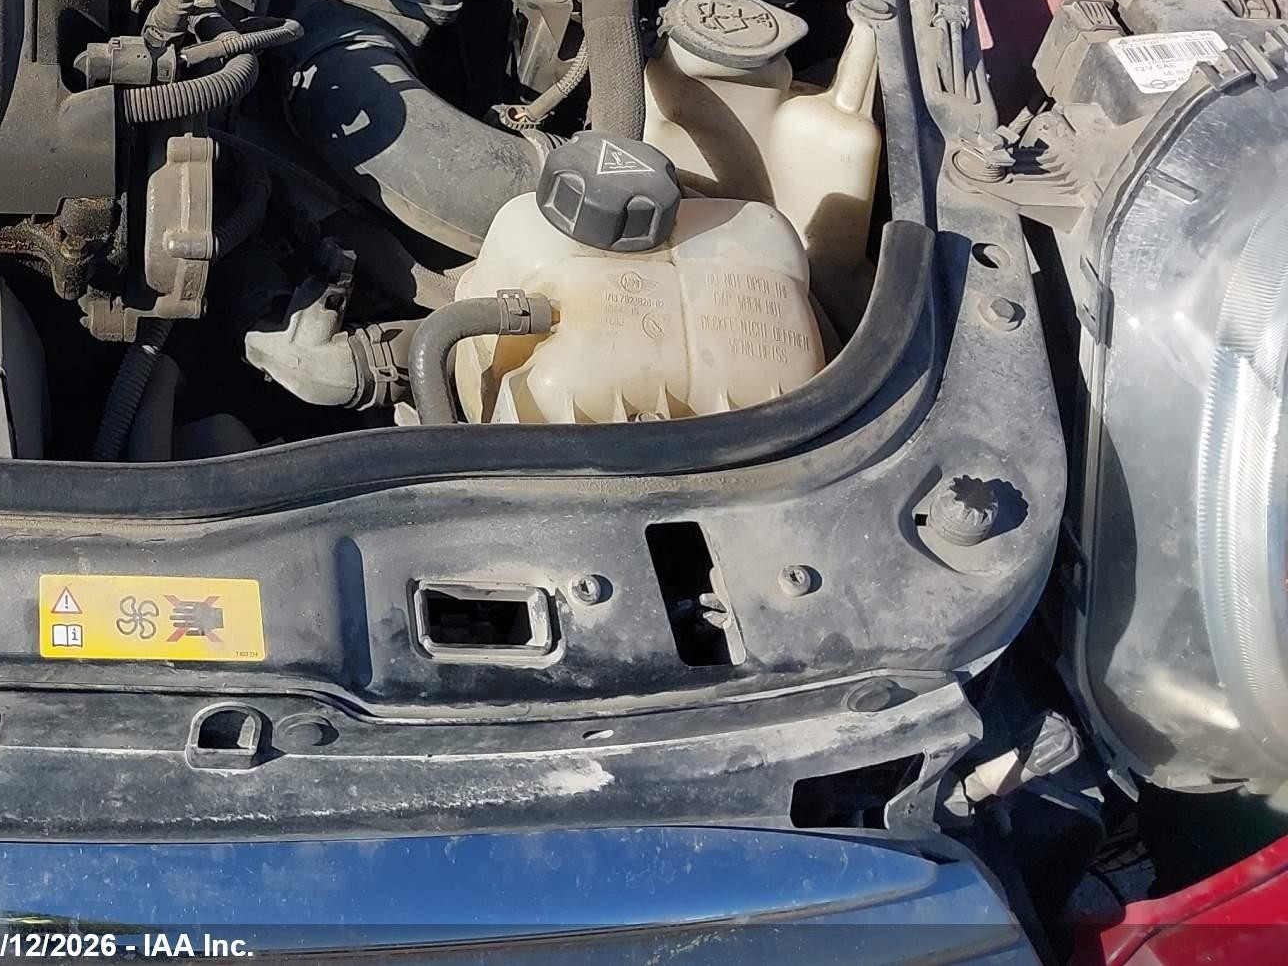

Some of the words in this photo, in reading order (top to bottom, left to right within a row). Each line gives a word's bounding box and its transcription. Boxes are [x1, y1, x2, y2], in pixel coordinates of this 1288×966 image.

[723, 273, 740, 289] NOT
[745, 274, 770, 295] OPEN
[713, 289, 731, 307] CAP
[736, 294, 762, 313] WHEN
[765, 299, 782, 318] HOT
[700, 314, 735, 331] DECKEL
[740, 318, 767, 339] NICHT
[728, 337, 754, 357] WENN
[757, 342, 788, 363] HEISS
